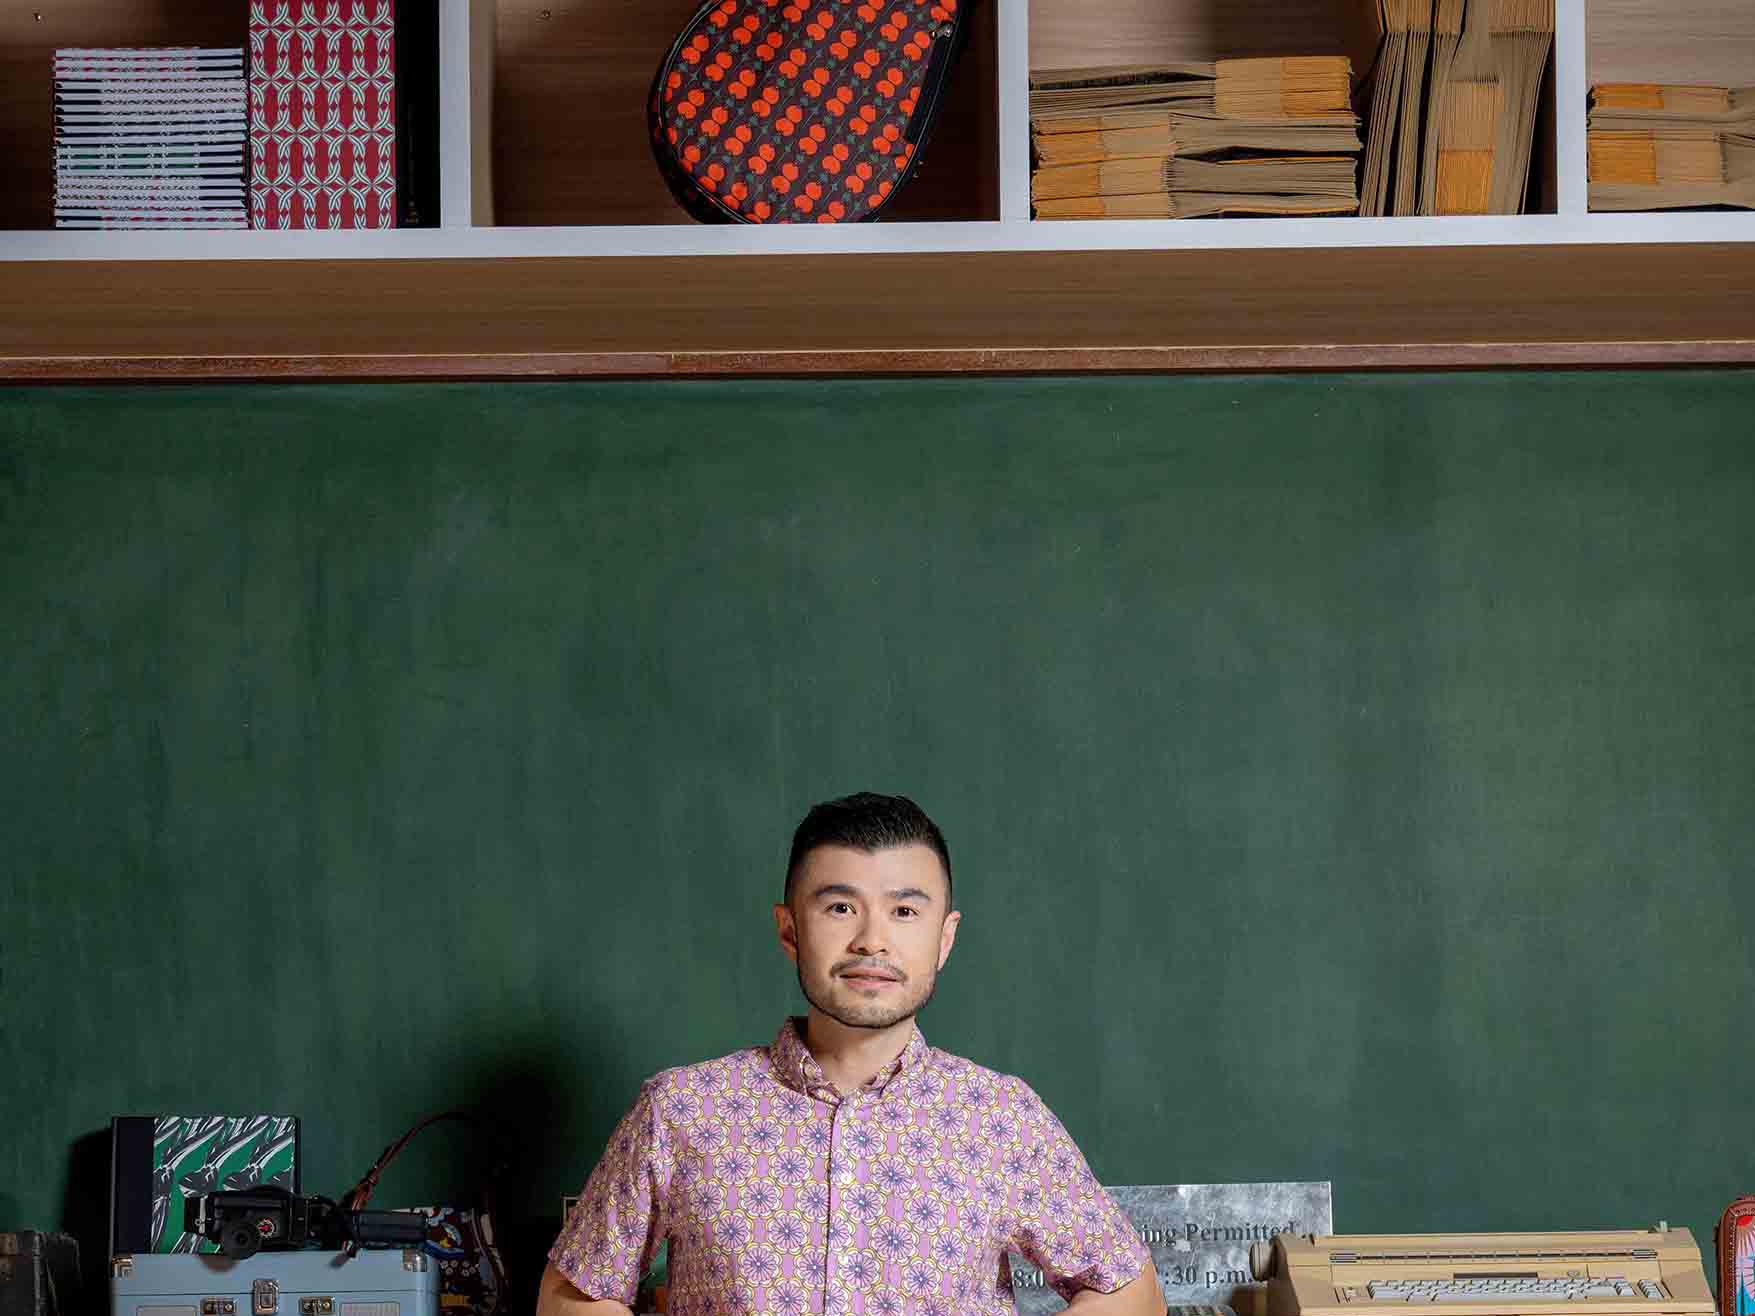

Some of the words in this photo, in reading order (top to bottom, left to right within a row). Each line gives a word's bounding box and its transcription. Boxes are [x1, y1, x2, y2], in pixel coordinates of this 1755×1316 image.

[1143, 1224, 1177, 1247] ing
[1014, 1269, 1046, 1288] 8:0
[1164, 1264, 1197, 1285] :30
[1205, 1270, 1253, 1288] p.m.
